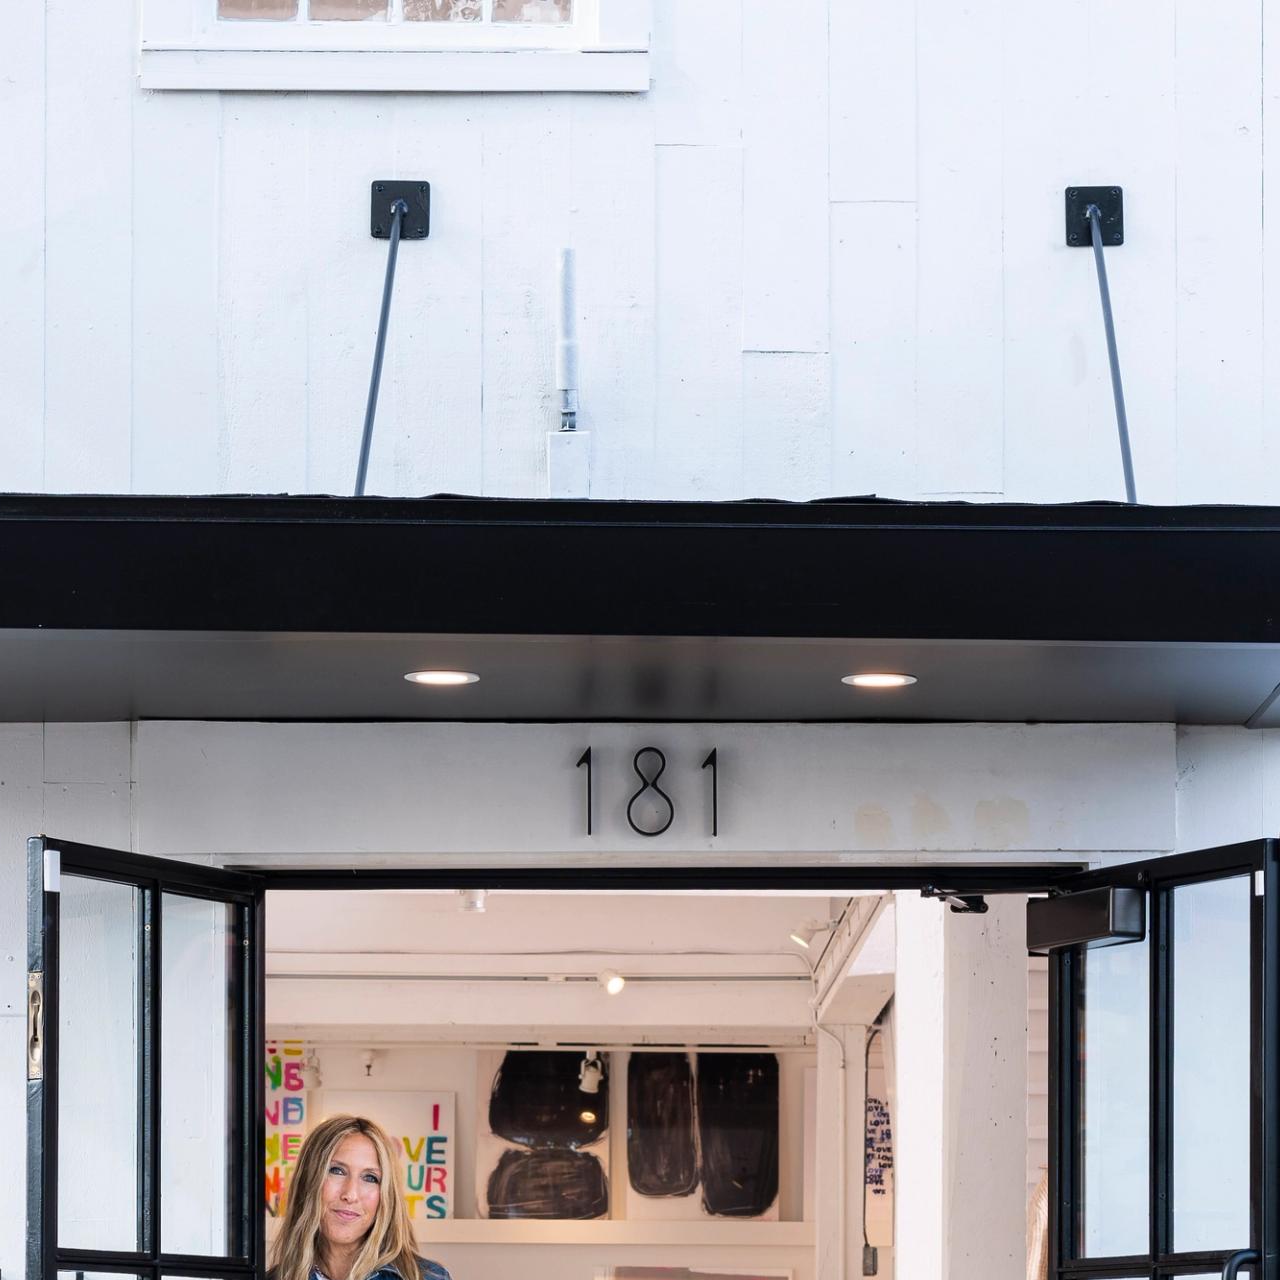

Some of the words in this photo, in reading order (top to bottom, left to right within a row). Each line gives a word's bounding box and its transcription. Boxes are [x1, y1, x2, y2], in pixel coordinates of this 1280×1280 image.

[575, 746, 717, 837] 181
[394, 1136, 447, 1165] VE
[406, 1164, 448, 1193] UR
[404, 1195, 447, 1219] TS
